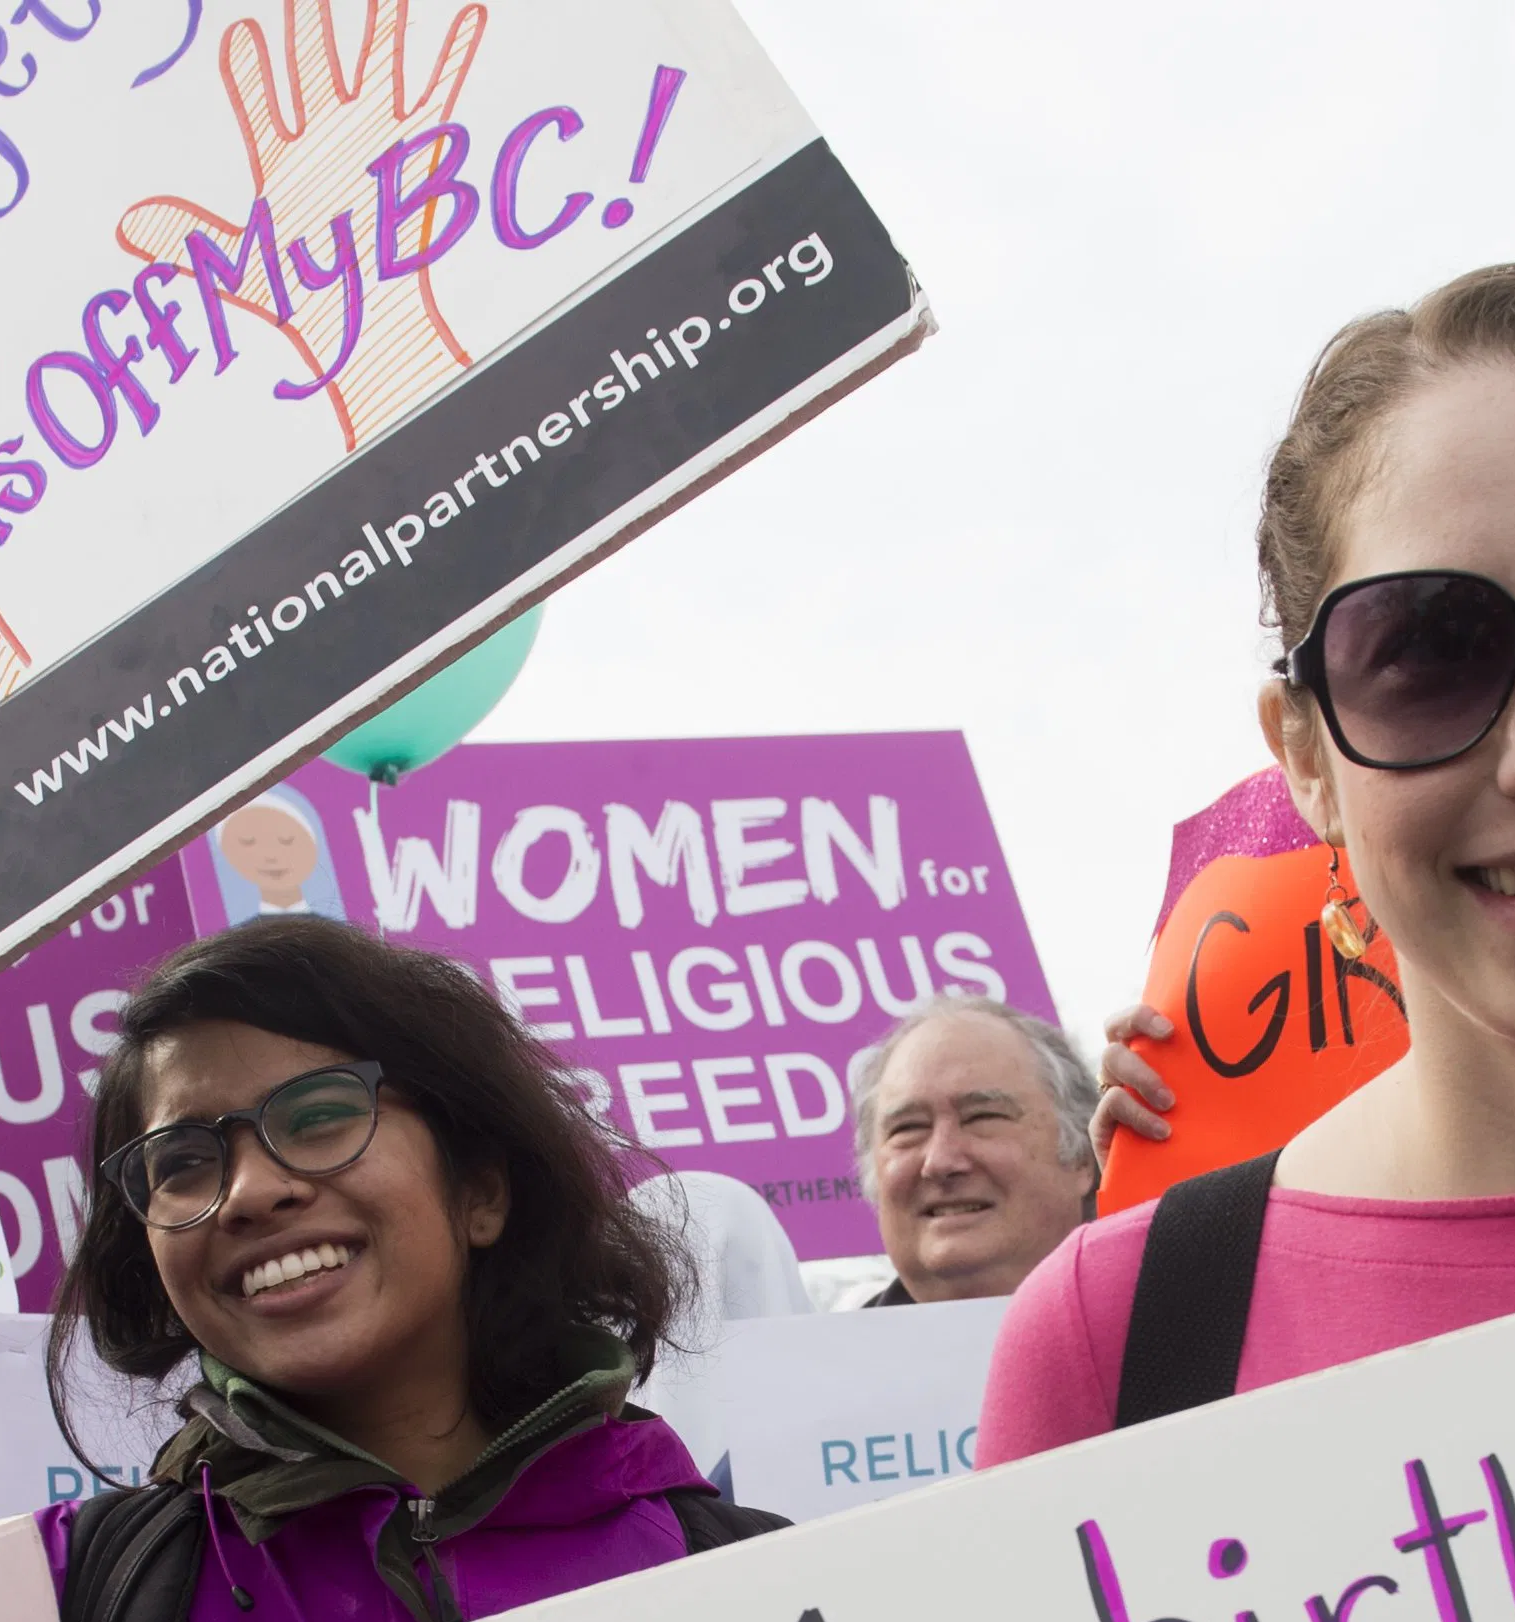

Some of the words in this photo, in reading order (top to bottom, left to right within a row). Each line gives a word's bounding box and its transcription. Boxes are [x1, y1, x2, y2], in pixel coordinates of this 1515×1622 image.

[14, 231, 835, 806] www.nationalpartnership.org
[352, 795, 901, 932] WOMEN
[919, 858, 990, 897] for
[489, 931, 1008, 1042] ELIGIOUS
